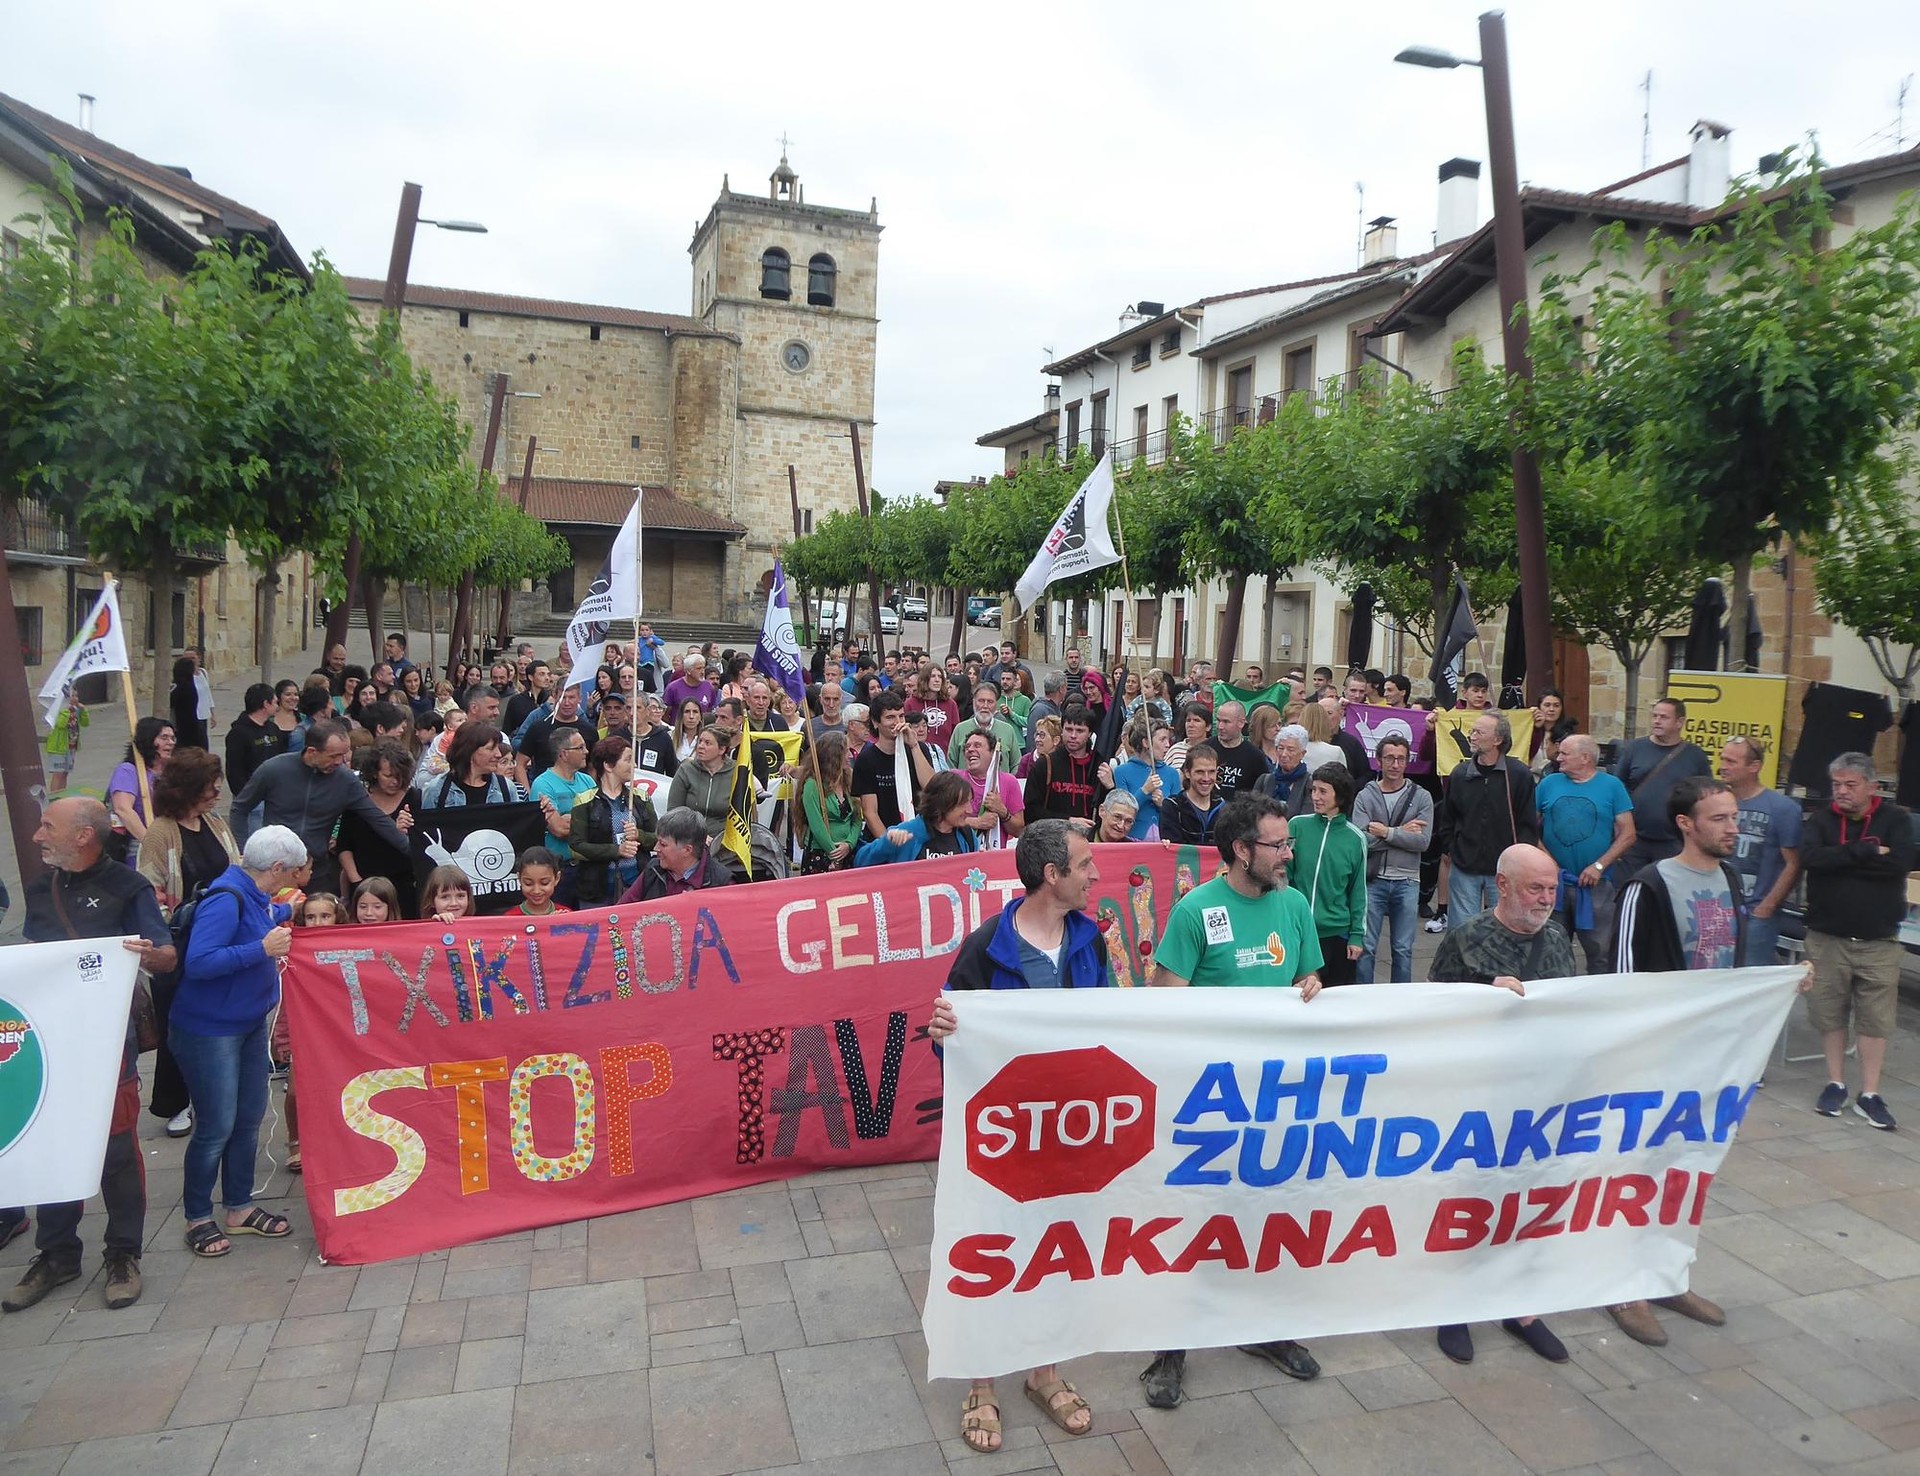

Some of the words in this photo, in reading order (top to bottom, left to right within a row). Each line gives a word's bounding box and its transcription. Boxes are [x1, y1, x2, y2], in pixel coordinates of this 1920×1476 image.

[771, 649, 797, 675] STOP!
[1685, 719, 1773, 739] GASBIDEA
[333, 1041, 675, 1217] STOP
[711, 1011, 908, 1165] TAV
[975, 1094, 1143, 1159] STOP
[1173, 1053, 1388, 1127] AHT
[1164, 1082, 1757, 1187] ZUNDAKETAK
[946, 1203, 1397, 1298] SAKANA
